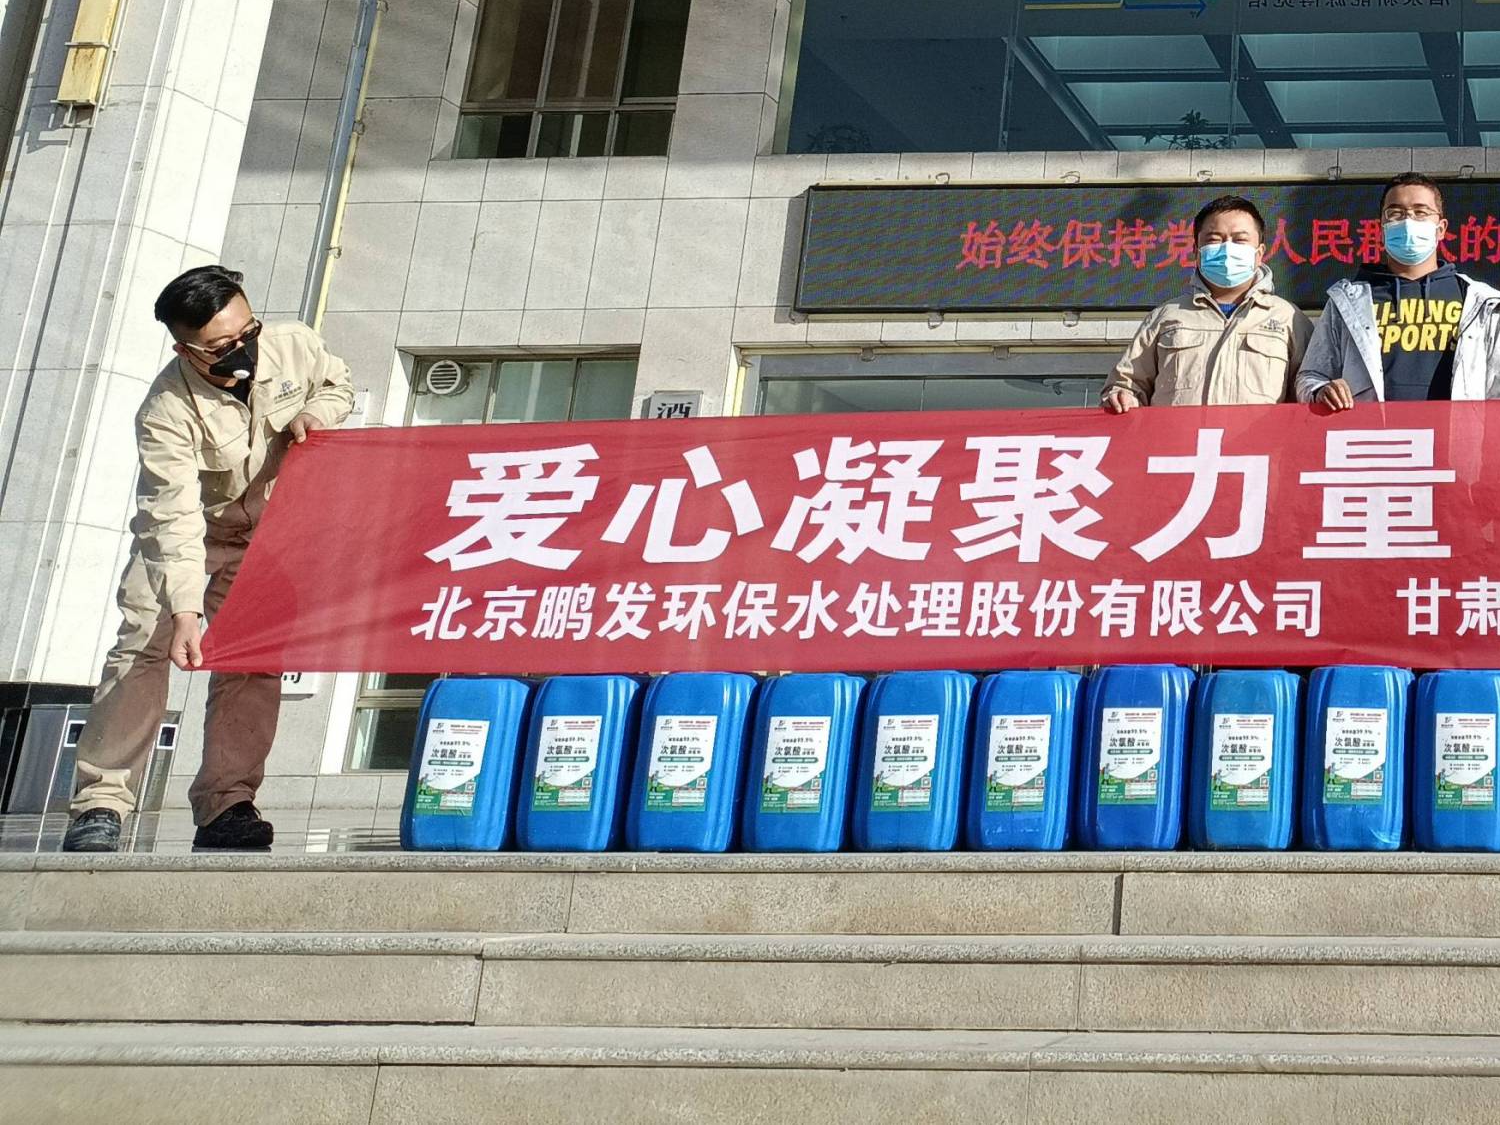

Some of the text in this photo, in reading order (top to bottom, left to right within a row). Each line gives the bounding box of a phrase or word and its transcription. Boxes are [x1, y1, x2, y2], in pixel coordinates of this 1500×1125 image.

[424, 428, 1457, 572] 爱心凝聚力量
[410, 578, 1322, 643] 北京鹏发环保水处理股份有限公司
